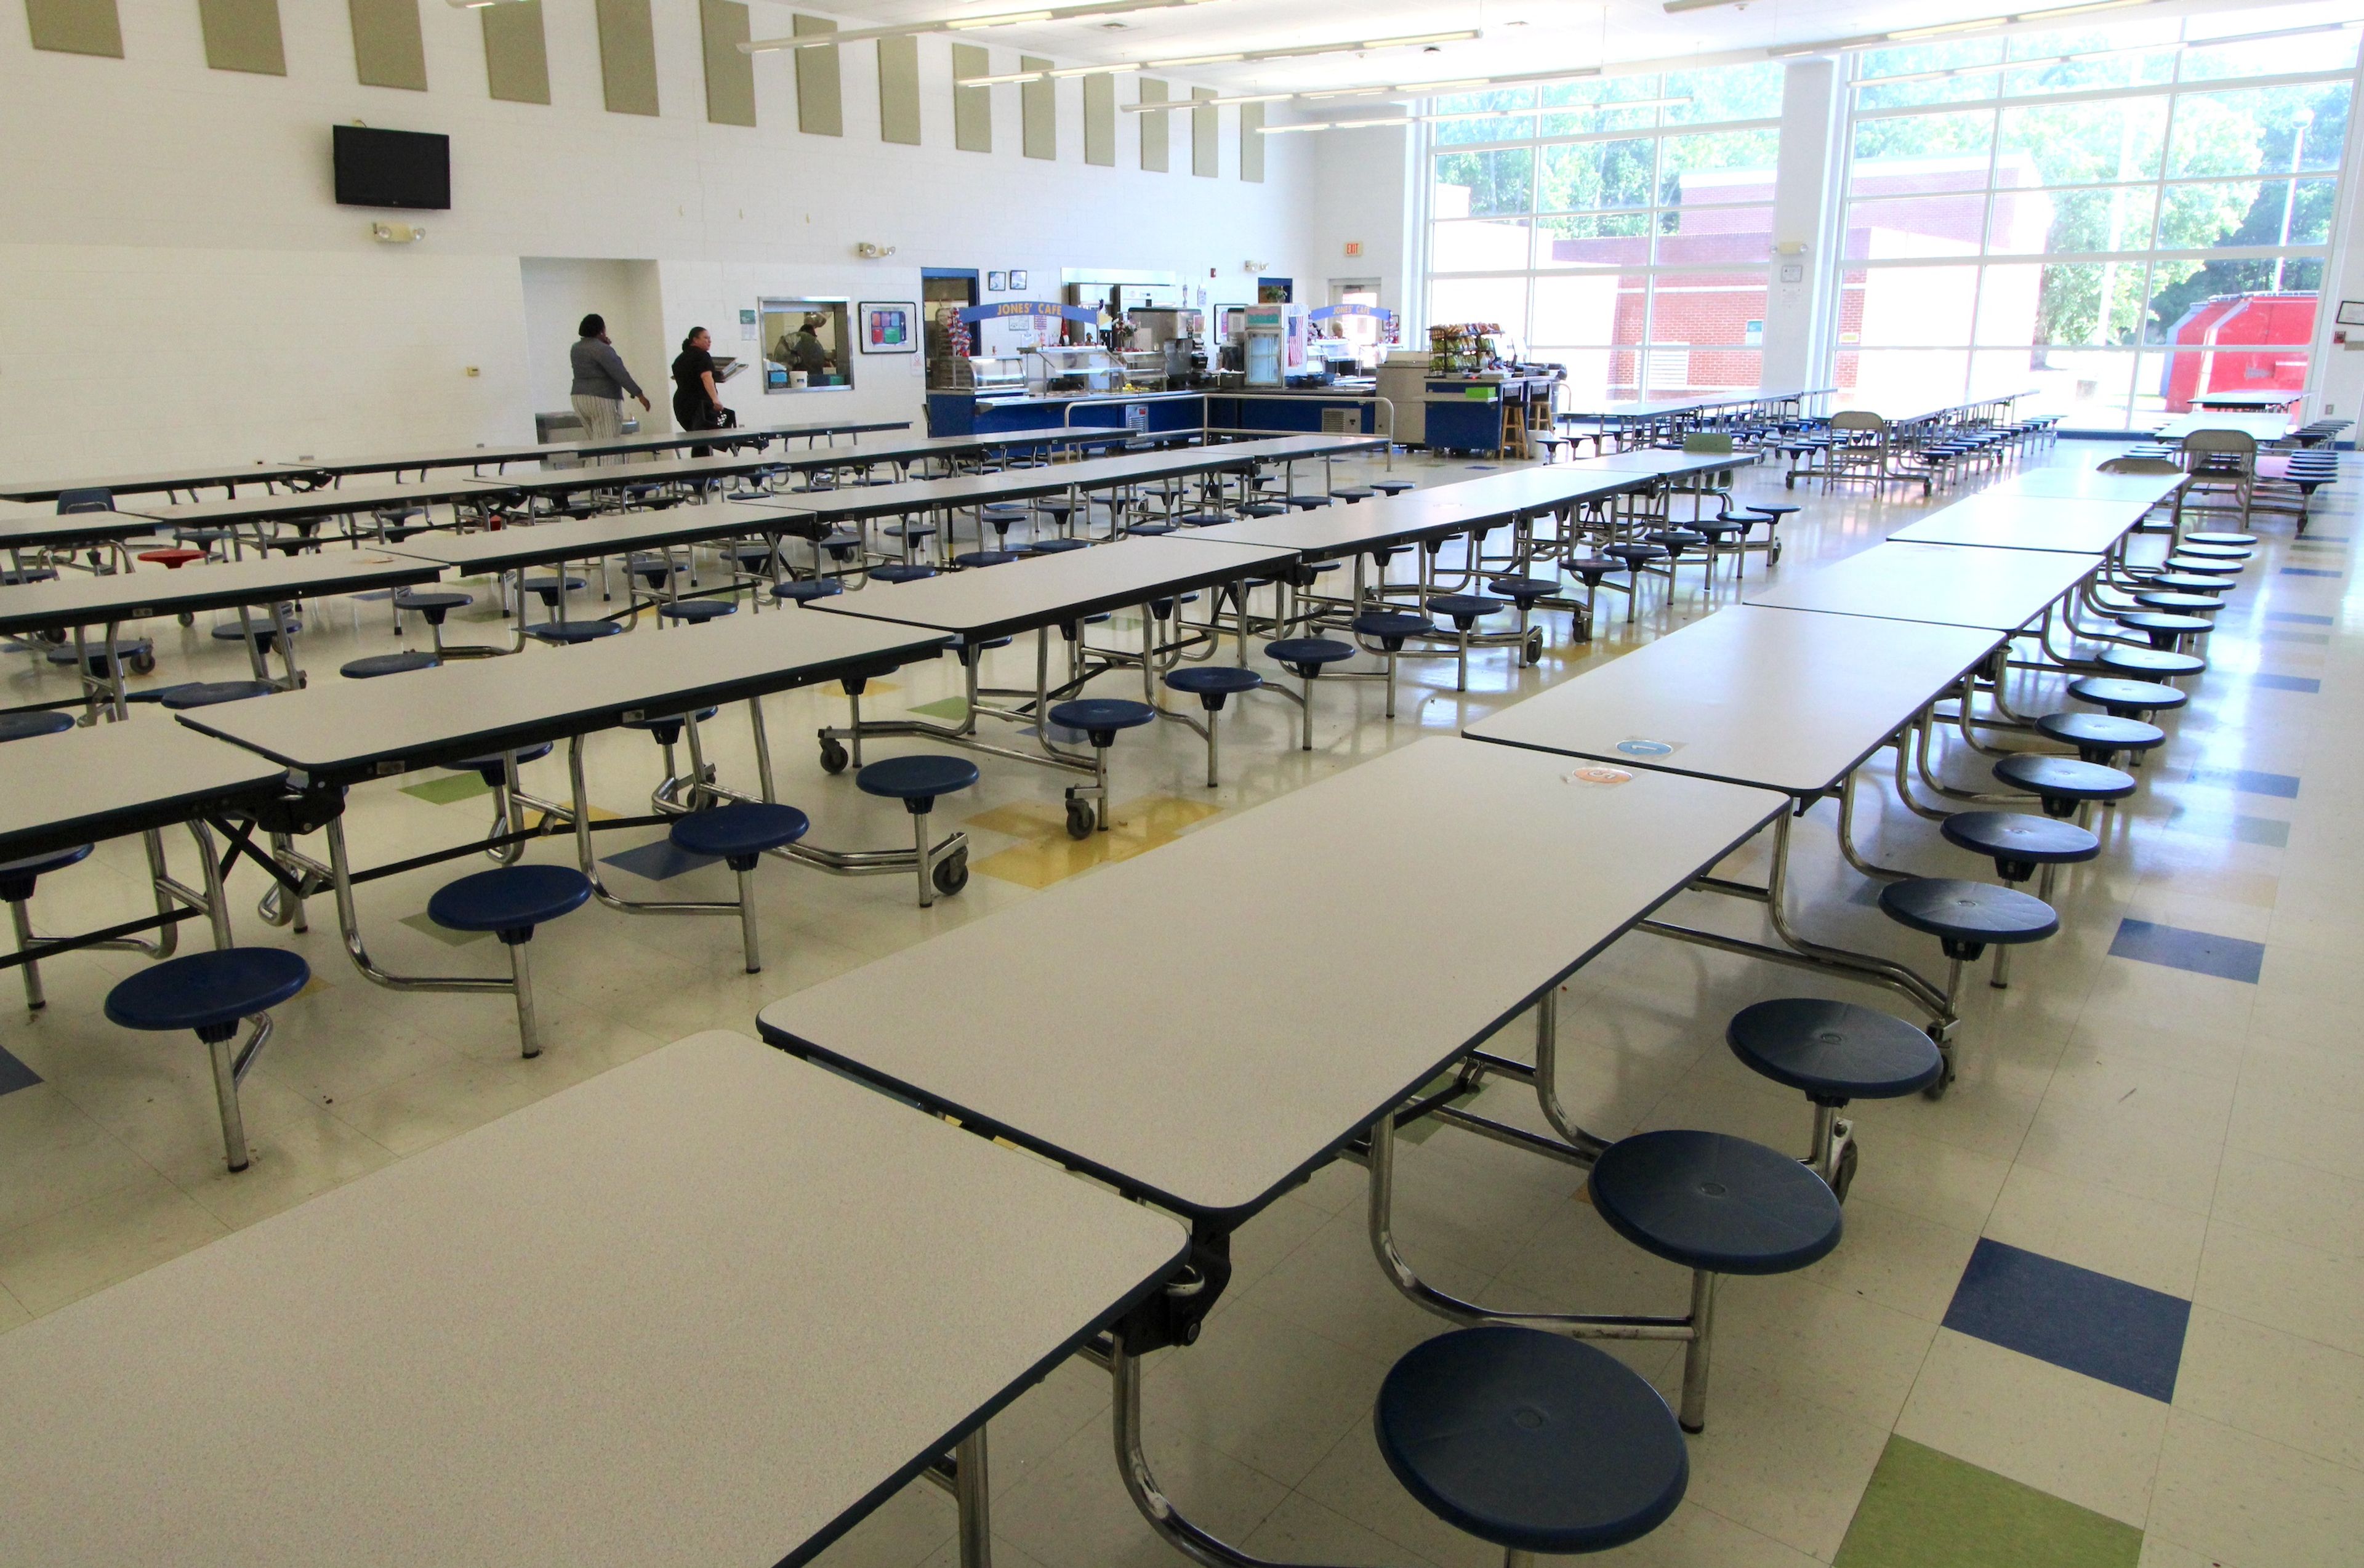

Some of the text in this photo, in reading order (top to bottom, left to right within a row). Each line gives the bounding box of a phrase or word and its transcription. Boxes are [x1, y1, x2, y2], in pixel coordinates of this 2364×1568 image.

[1347, 243, 1359, 254] EXIT
[997, 303, 1062, 316] JONES' CAFE
